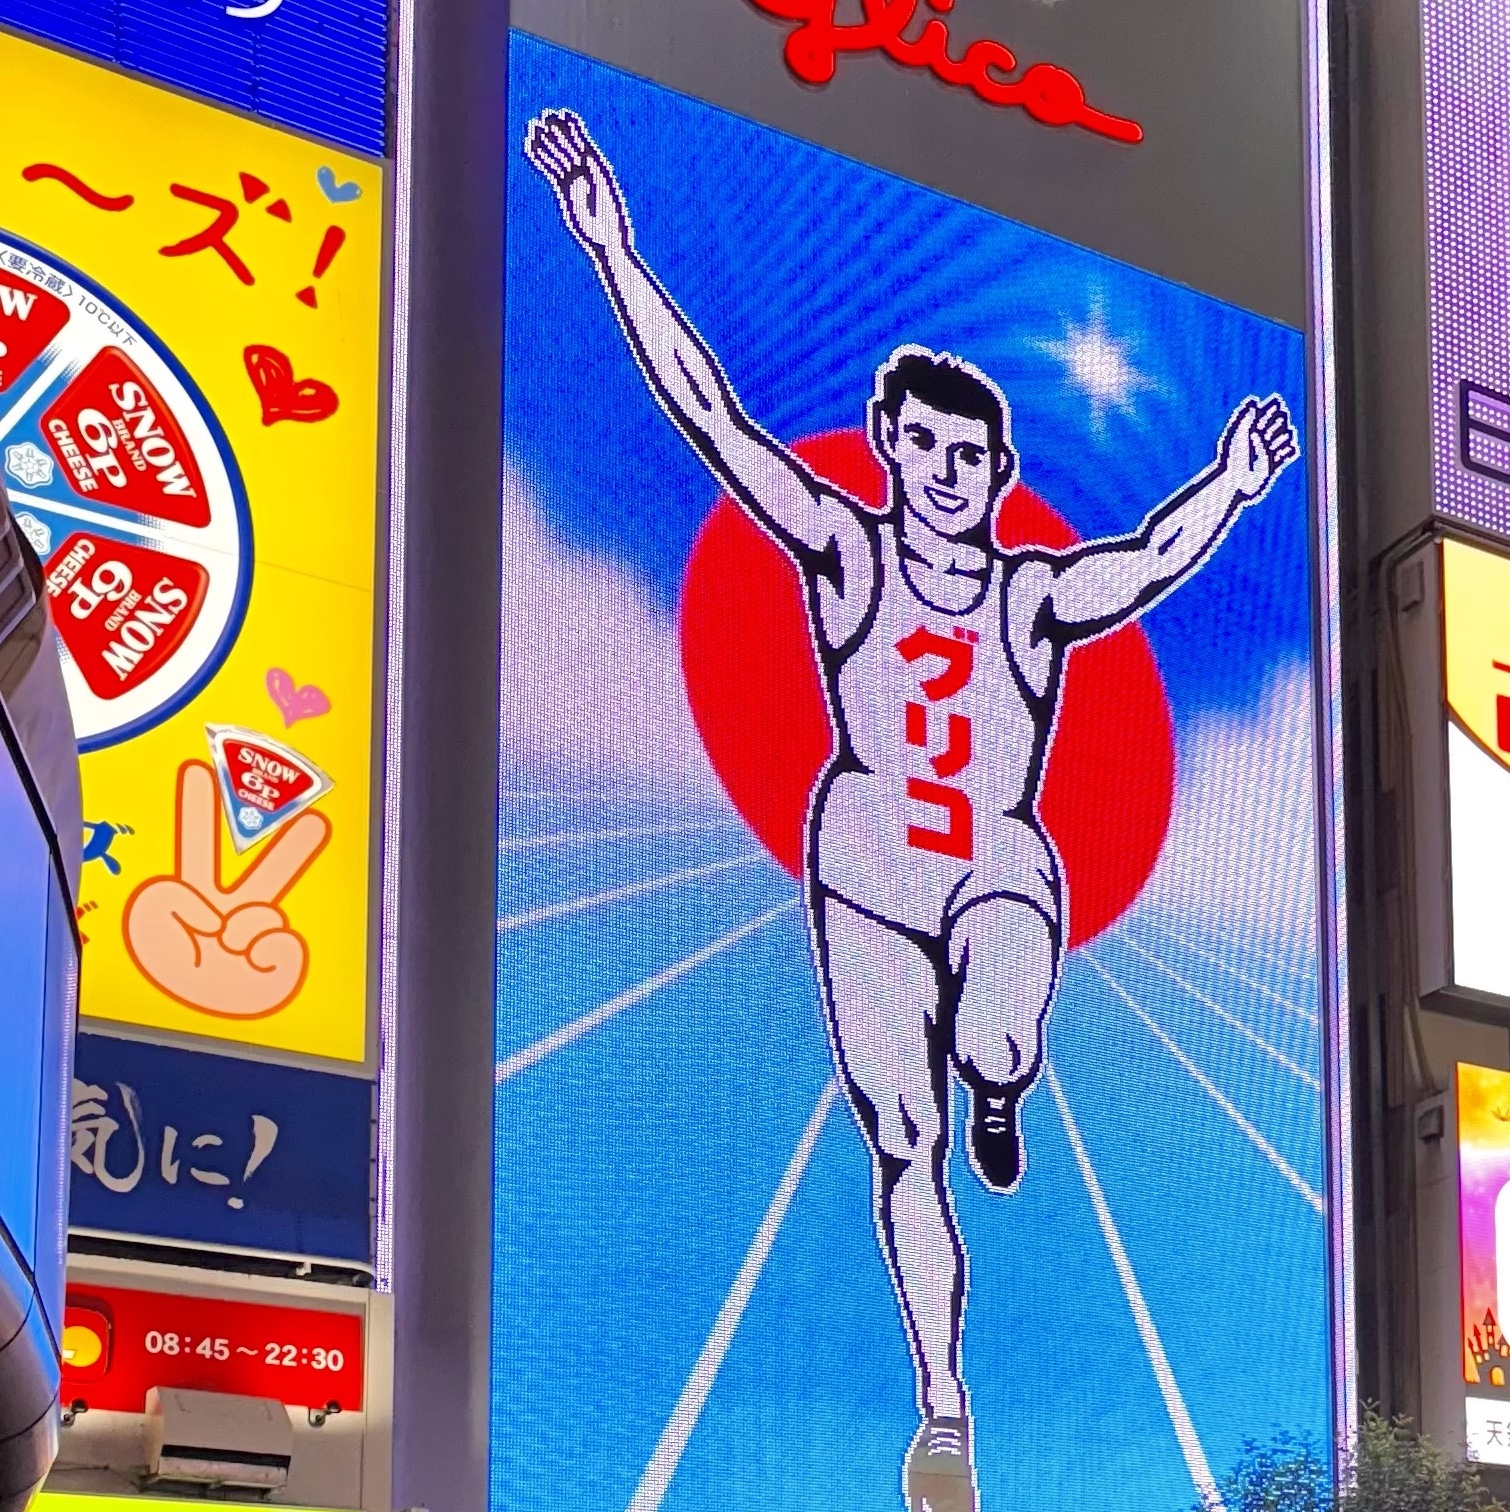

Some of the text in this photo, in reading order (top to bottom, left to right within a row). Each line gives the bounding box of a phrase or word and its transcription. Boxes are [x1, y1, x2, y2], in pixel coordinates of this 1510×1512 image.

[46, 417, 99, 493] CHEESE
[76, 407, 128, 489] 6P
[108, 381, 198, 500] SNOW
[113, 418, 149, 474] BRAND
[46, 538, 96, 598] CHEESE
[68, 558, 134, 621] 6P
[100, 576, 189, 682] SNOW
[104, 587, 142, 633] BRAND
[237, 747, 301, 785] SNOW
[893, 624, 980, 862] グリコ
[240, 771, 281, 801] 6P
